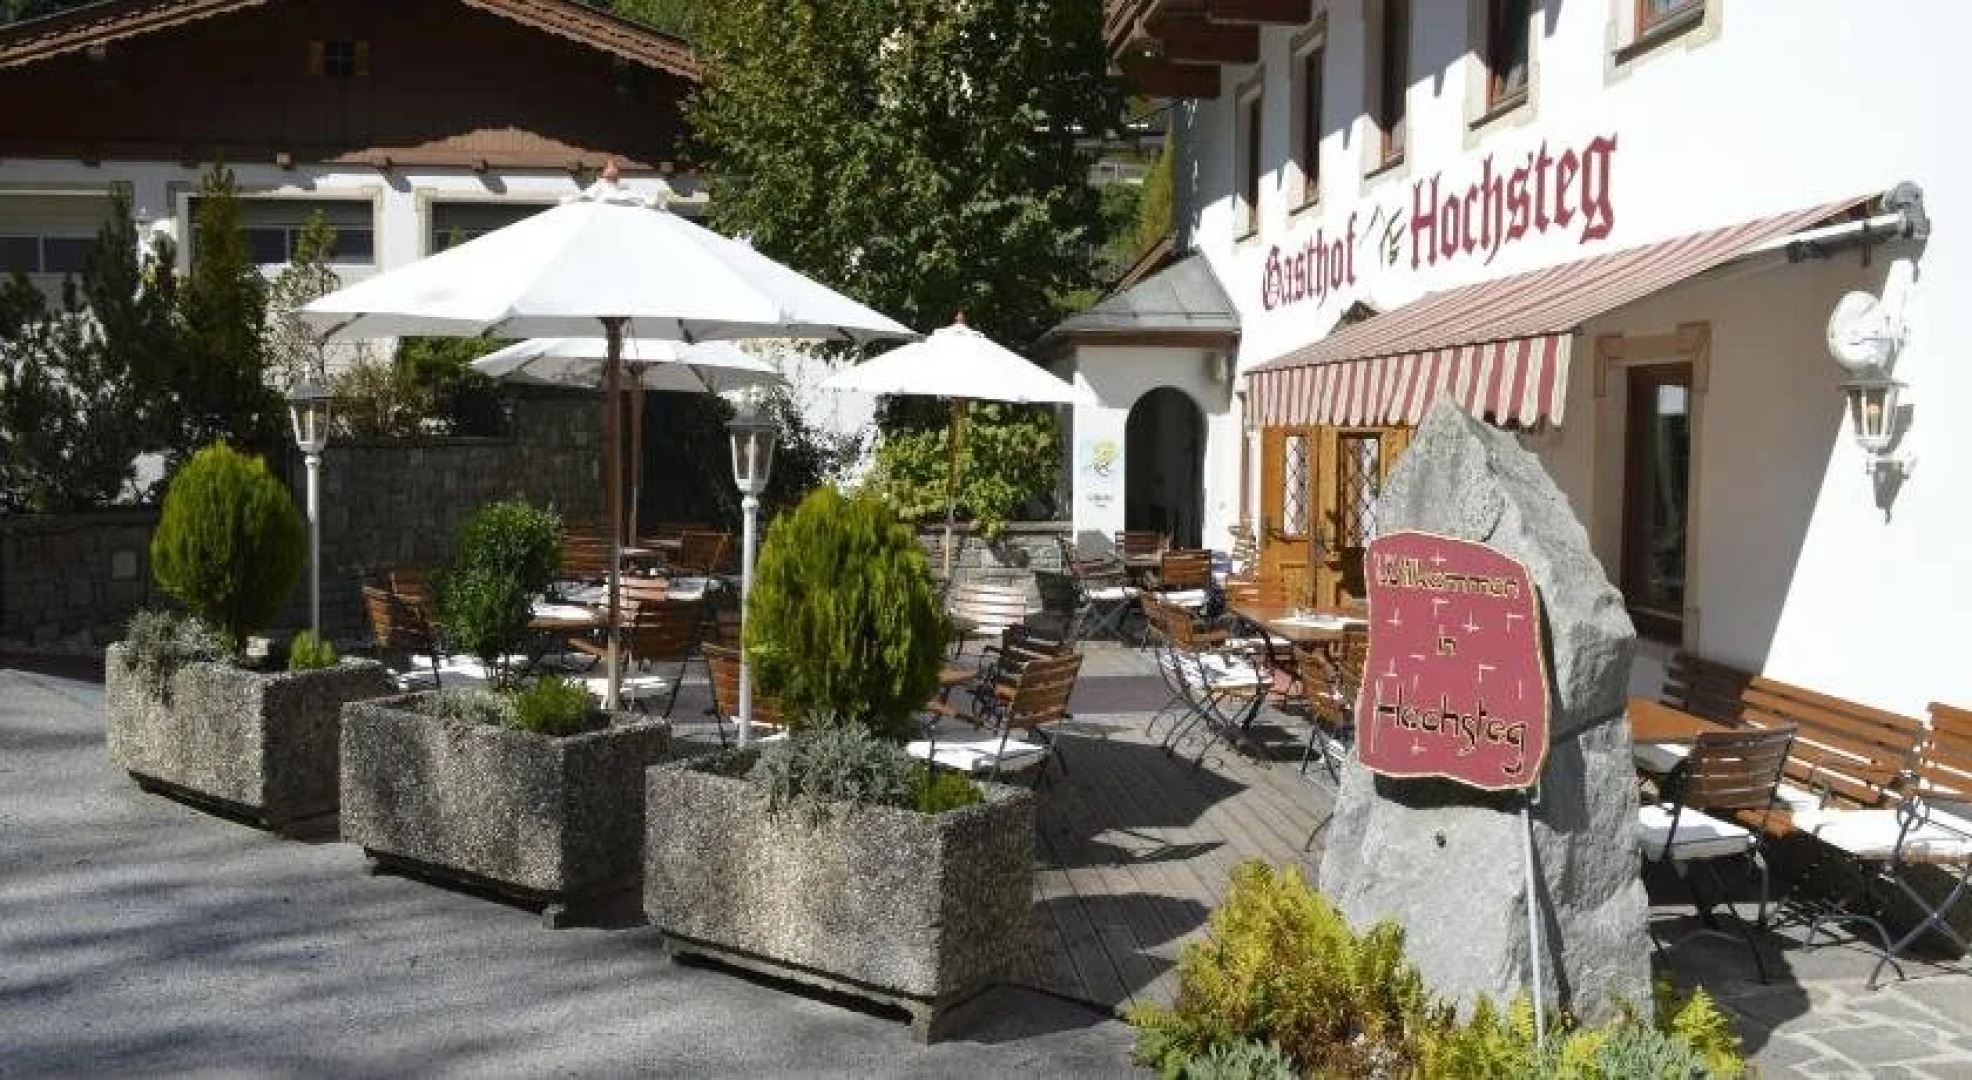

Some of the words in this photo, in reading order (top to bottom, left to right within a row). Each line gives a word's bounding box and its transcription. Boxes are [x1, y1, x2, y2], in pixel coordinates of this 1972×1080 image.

[1262, 211, 1357, 311] Gasthof
[1411, 132, 1617, 271] Hochsteg
[1373, 551, 1520, 600] Willkommen
[1436, 624, 1457, 656] in
[1370, 678, 1528, 776] Hochsteg
